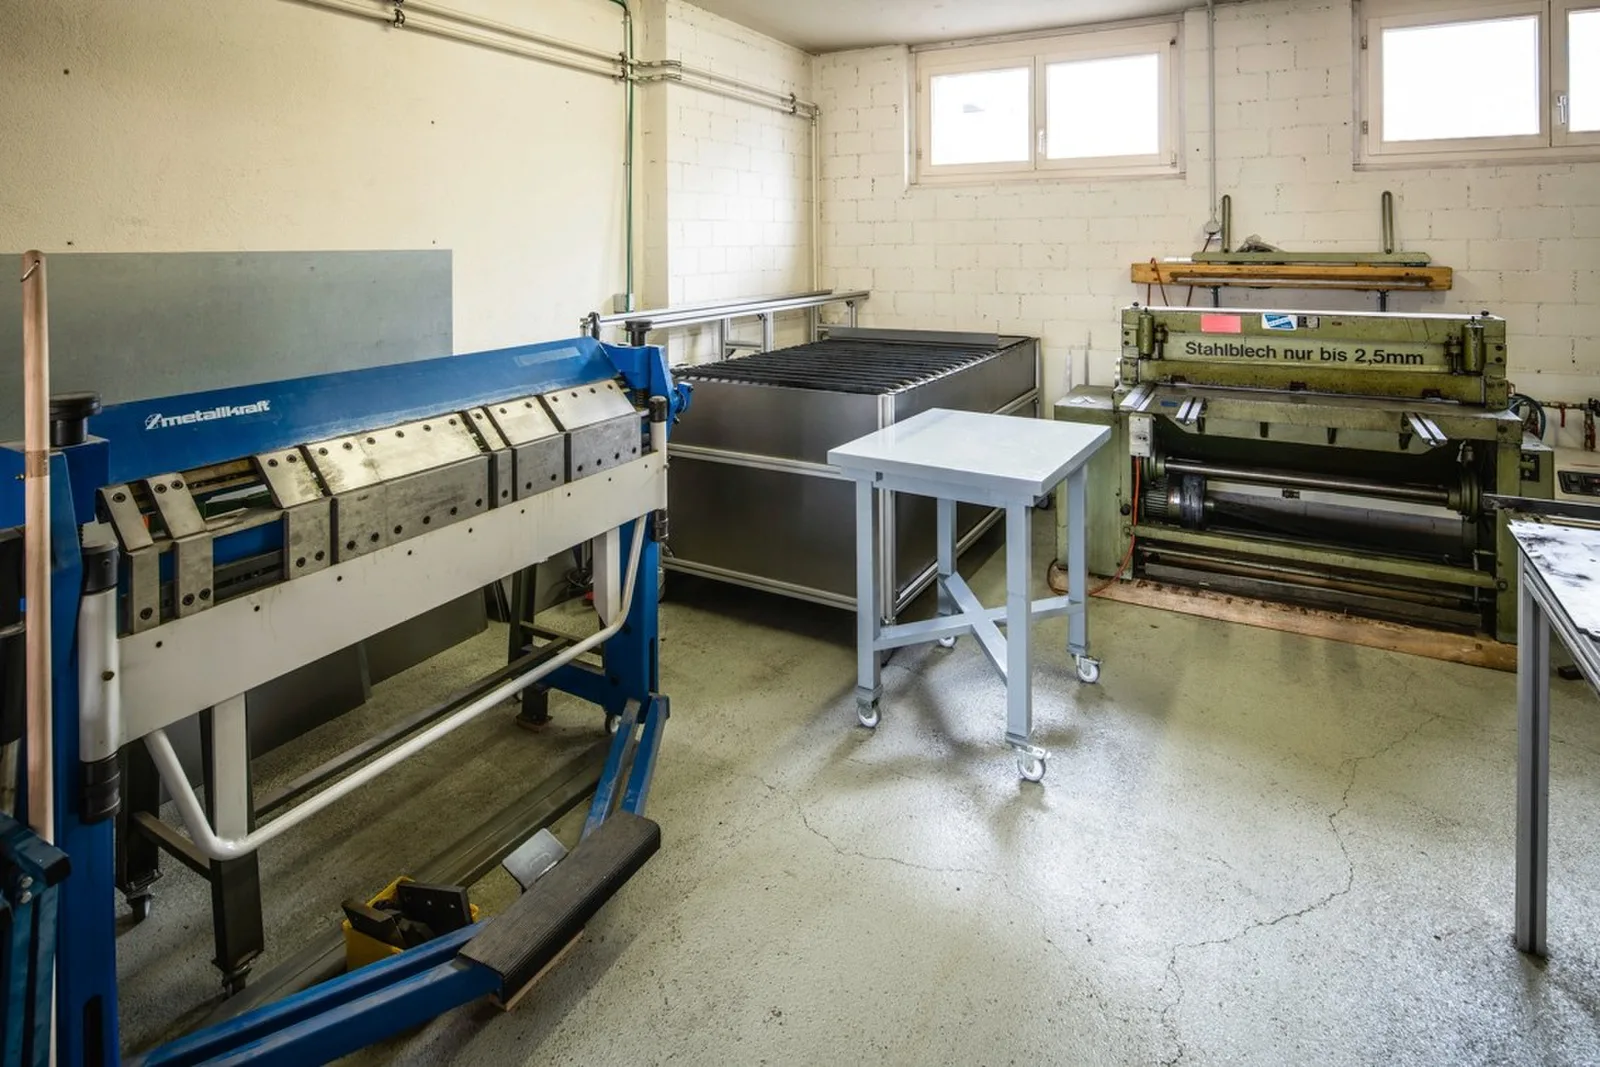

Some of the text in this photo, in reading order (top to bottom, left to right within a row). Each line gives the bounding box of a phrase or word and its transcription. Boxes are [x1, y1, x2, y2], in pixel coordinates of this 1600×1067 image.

[1185, 341, 1425, 366] Stahlblech nur bis 2,5mm
[161, 400, 271, 428] metallkraft
